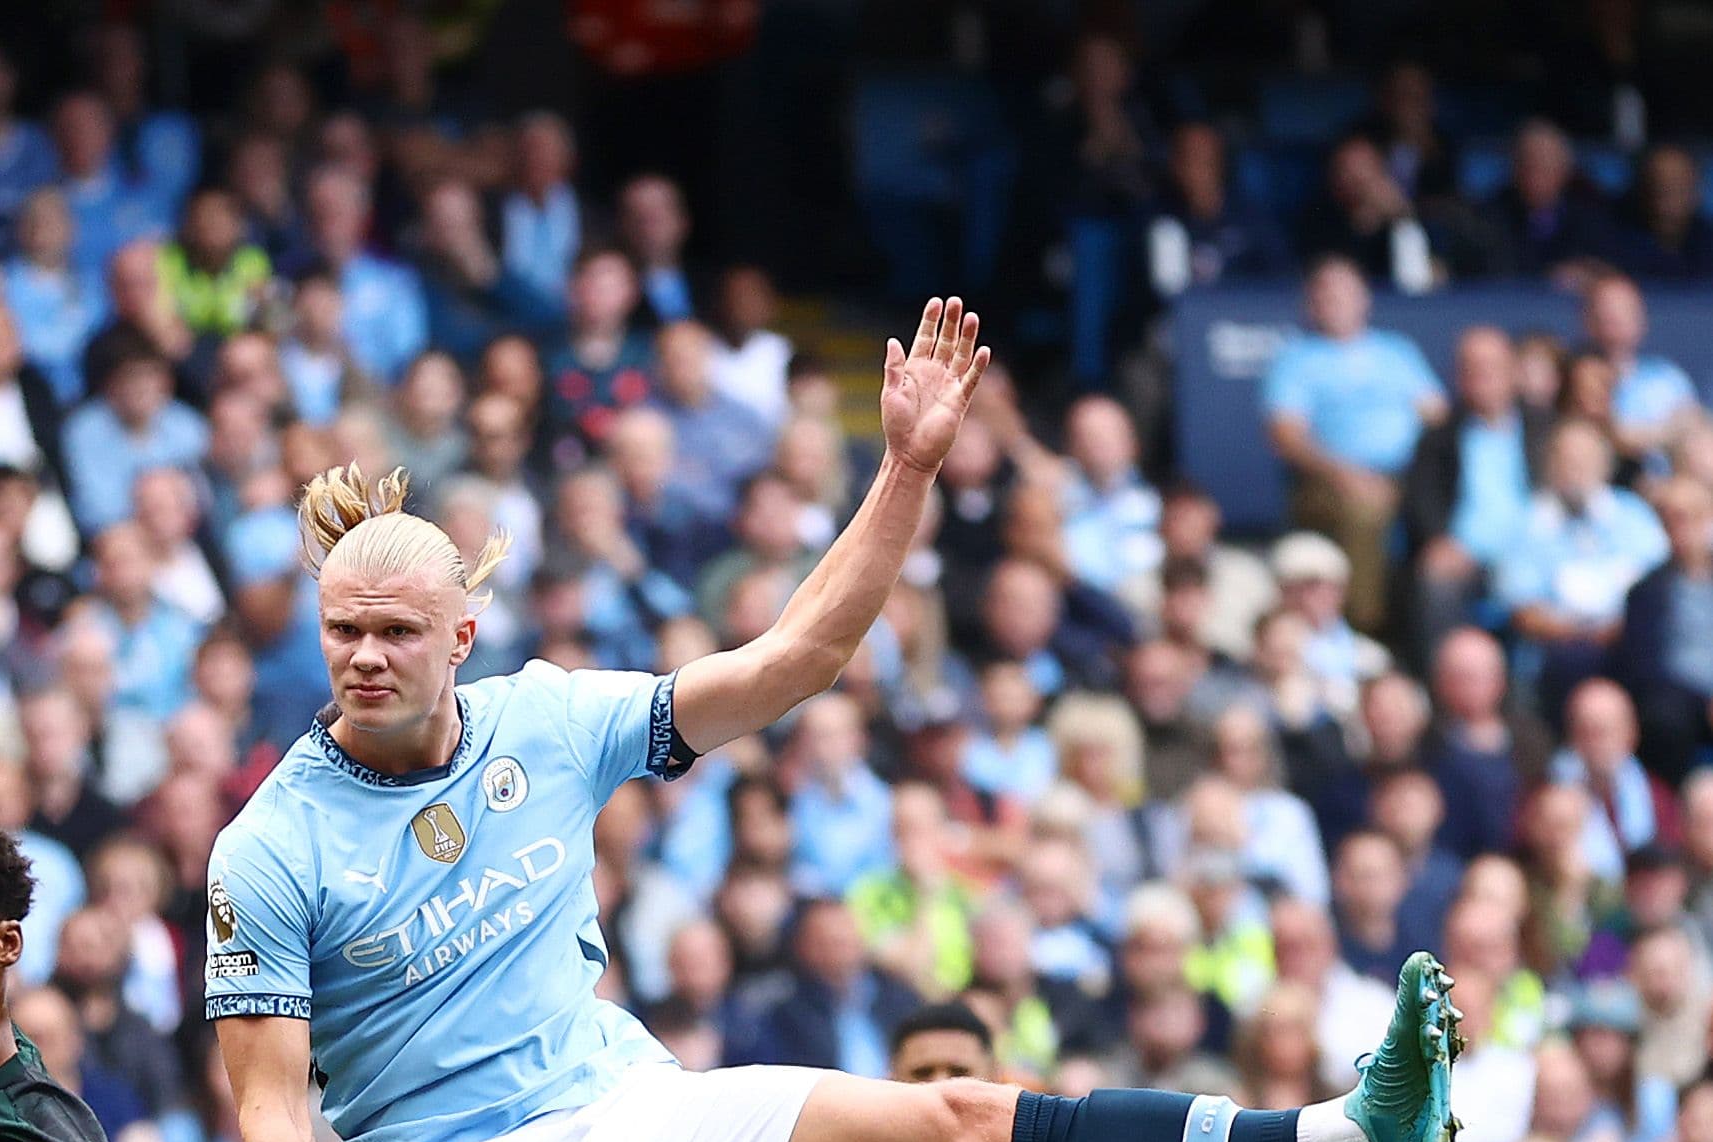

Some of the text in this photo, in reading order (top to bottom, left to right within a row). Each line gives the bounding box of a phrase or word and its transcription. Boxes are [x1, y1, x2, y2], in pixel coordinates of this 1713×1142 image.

[434, 839, 457, 854] FIFA
[342, 836, 566, 968] ETIHAD
[218, 953, 253, 967] room
[404, 900, 535, 986] AIRWAYS
